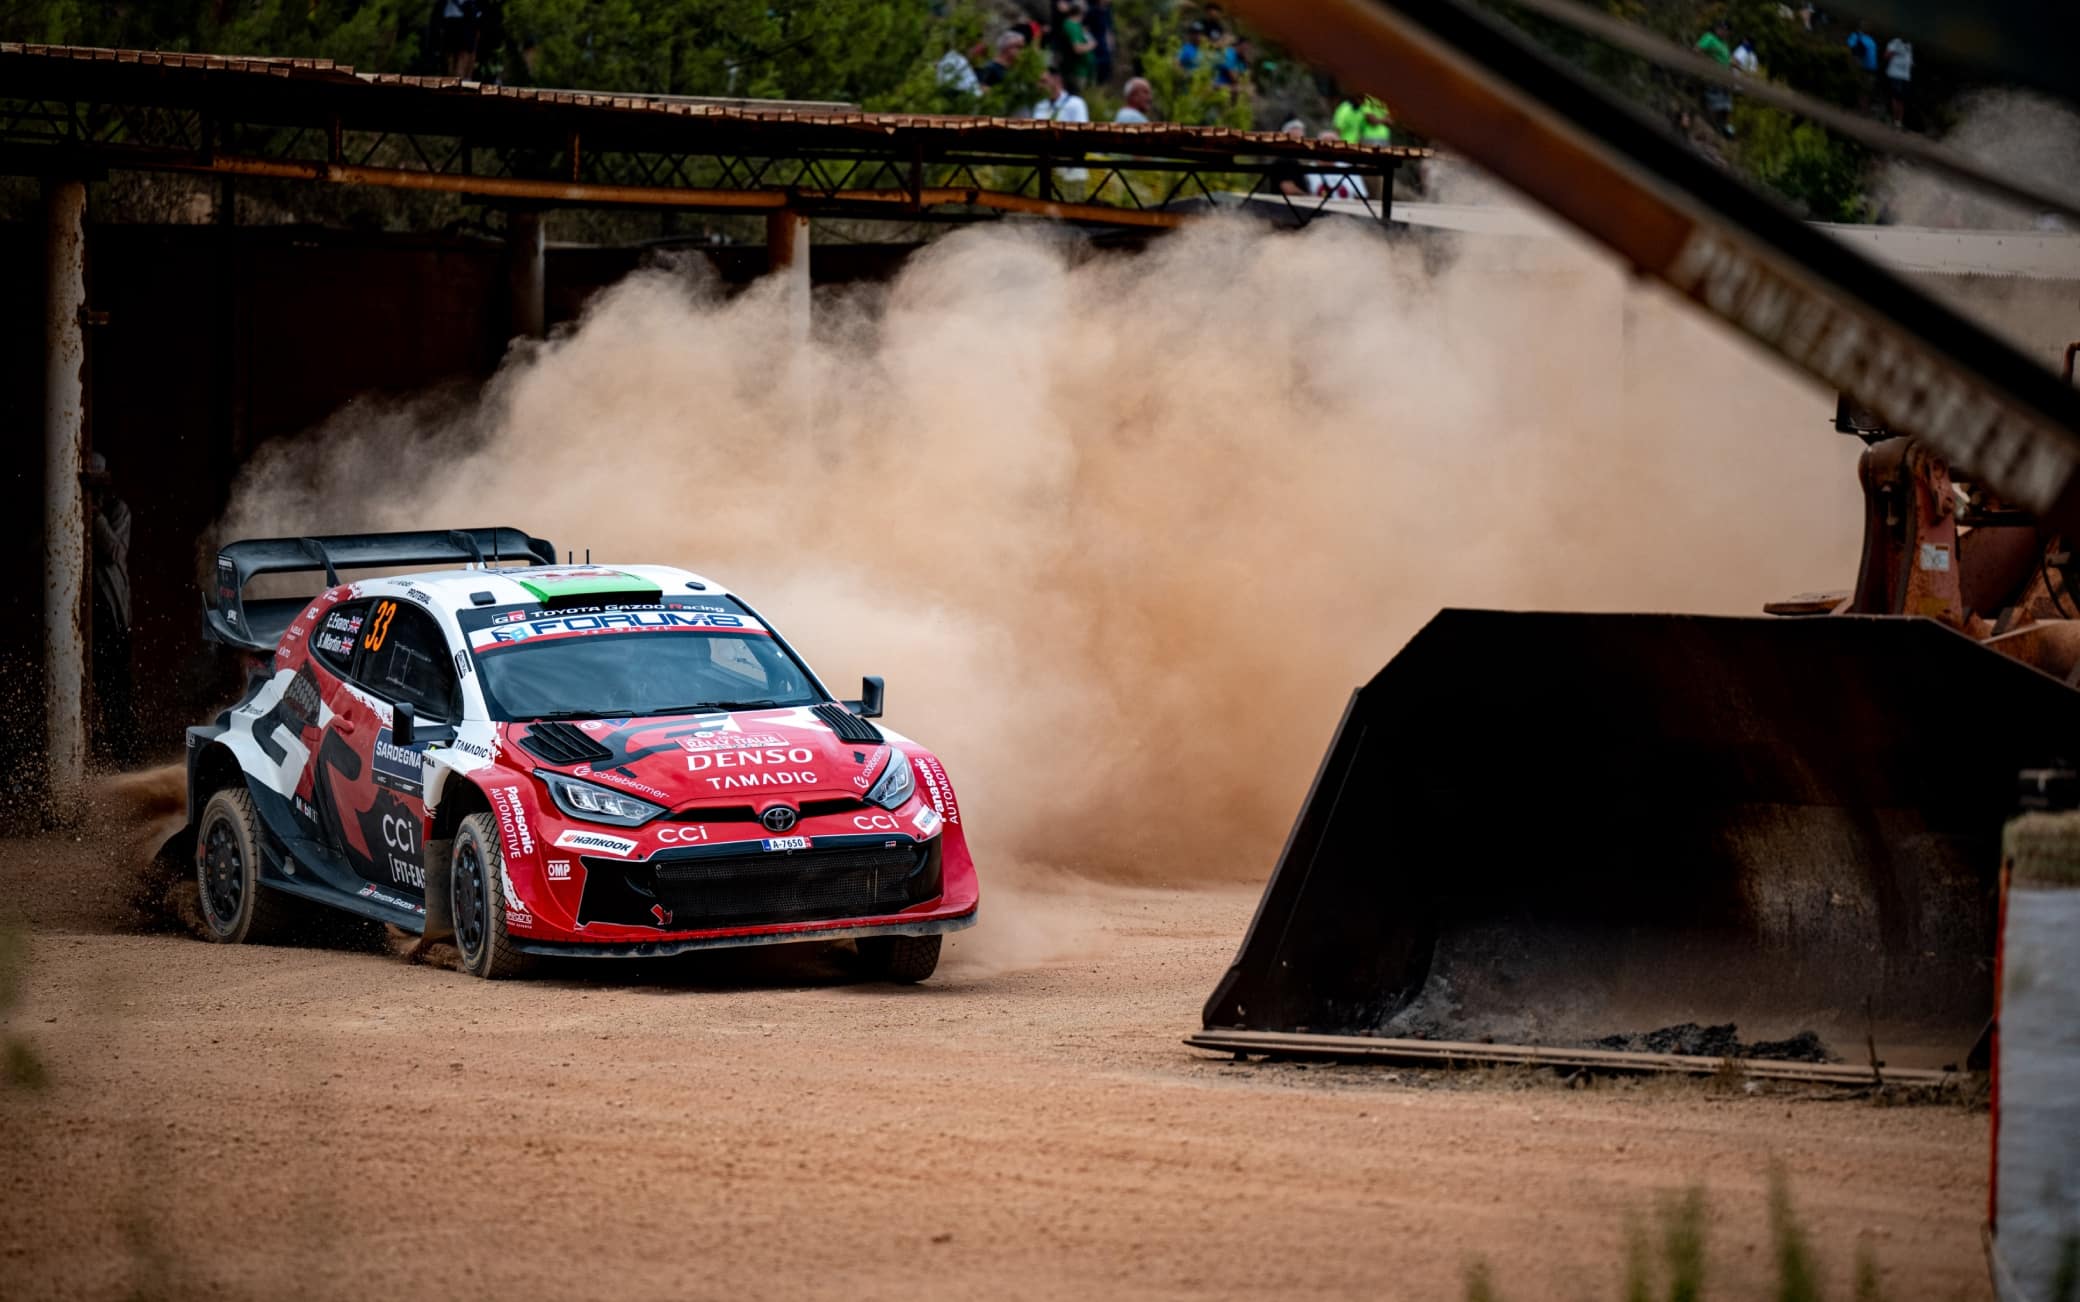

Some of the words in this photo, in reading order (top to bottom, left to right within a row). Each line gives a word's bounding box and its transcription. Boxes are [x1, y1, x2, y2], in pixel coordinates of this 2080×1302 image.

[494, 610, 526, 624] GR
[531, 606, 600, 616] TOYOTA
[669, 603, 725, 613] Racing
[326, 612, 350, 631] E.Evans
[365, 600, 396, 651] 33
[530, 613, 743, 634] FORUM8
[317, 632, 342, 653] S.Martin
[456, 740, 488, 758] TAMADIC
[686, 737, 729, 749] RALLY
[734, 734, 777, 746] ITALIA
[376, 741, 421, 768] SARDEGNA
[686, 748, 813, 771] DENSO
[593, 771, 669, 799] codebeamer
[706, 771, 817, 790] TAMADIC
[915, 758, 946, 823] Panasonic
[925, 756, 959, 824] AUTOMOTIVE
[490, 788, 521, 859] AUTOMOTIVE
[504, 786, 535, 855] Panasonic
[382, 814, 415, 854] CCi
[657, 825, 708, 843] CCi
[773, 838, 803, 849] A-7650
[548, 864, 571, 877] OMP
